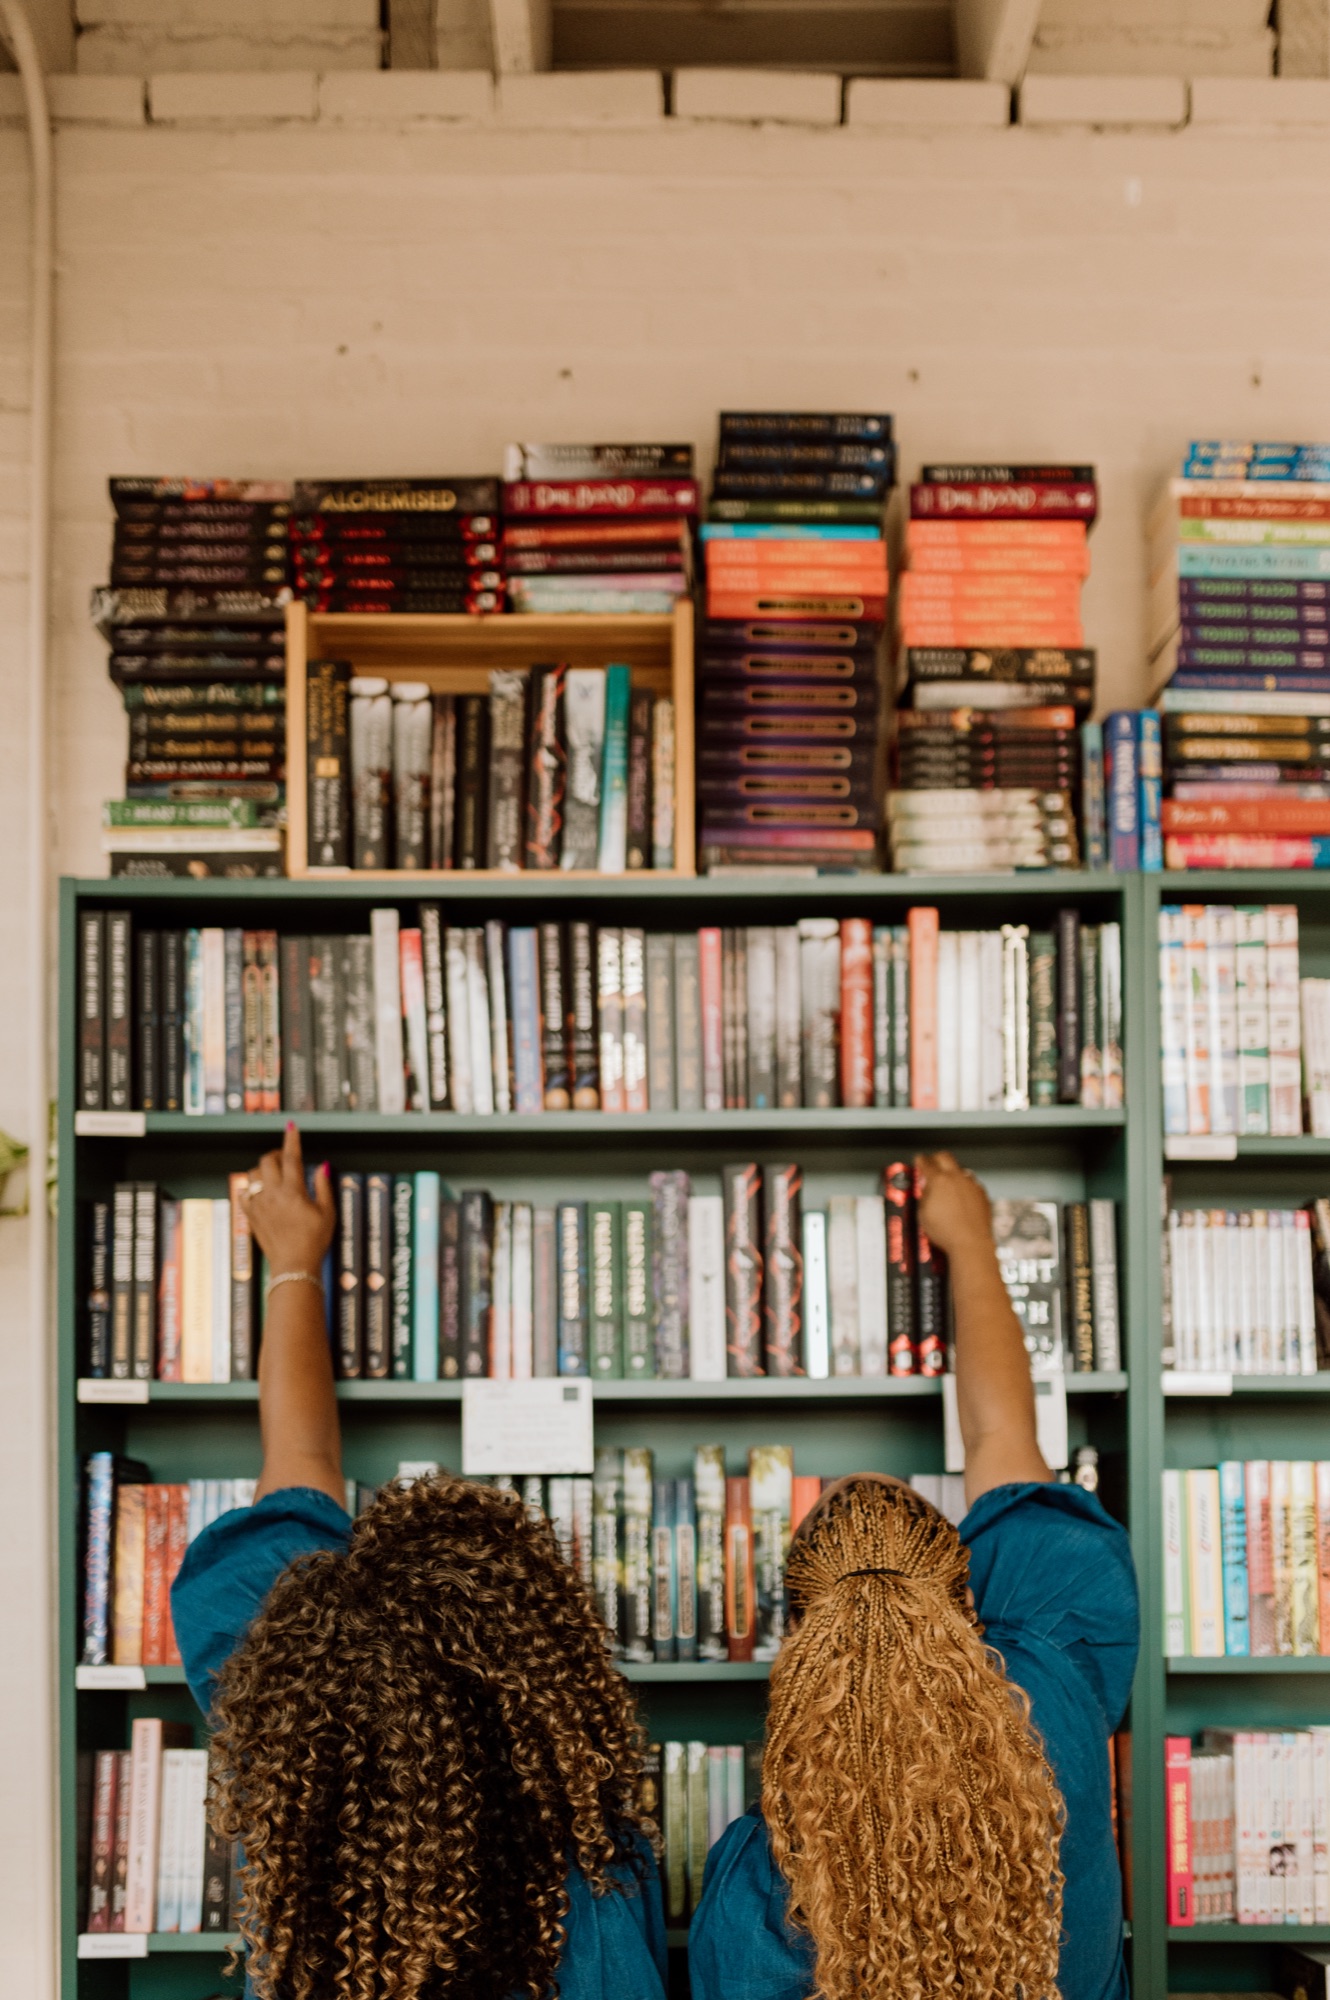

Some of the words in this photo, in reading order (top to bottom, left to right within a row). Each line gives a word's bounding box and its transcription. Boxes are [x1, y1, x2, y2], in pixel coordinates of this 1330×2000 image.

[318, 489, 457, 511] ALCHEMISED
[1173, 1782, 1187, 1803] THE
[1173, 1803, 1188, 1842] MANGA
[1174, 1843, 1189, 1874] BIBLE
